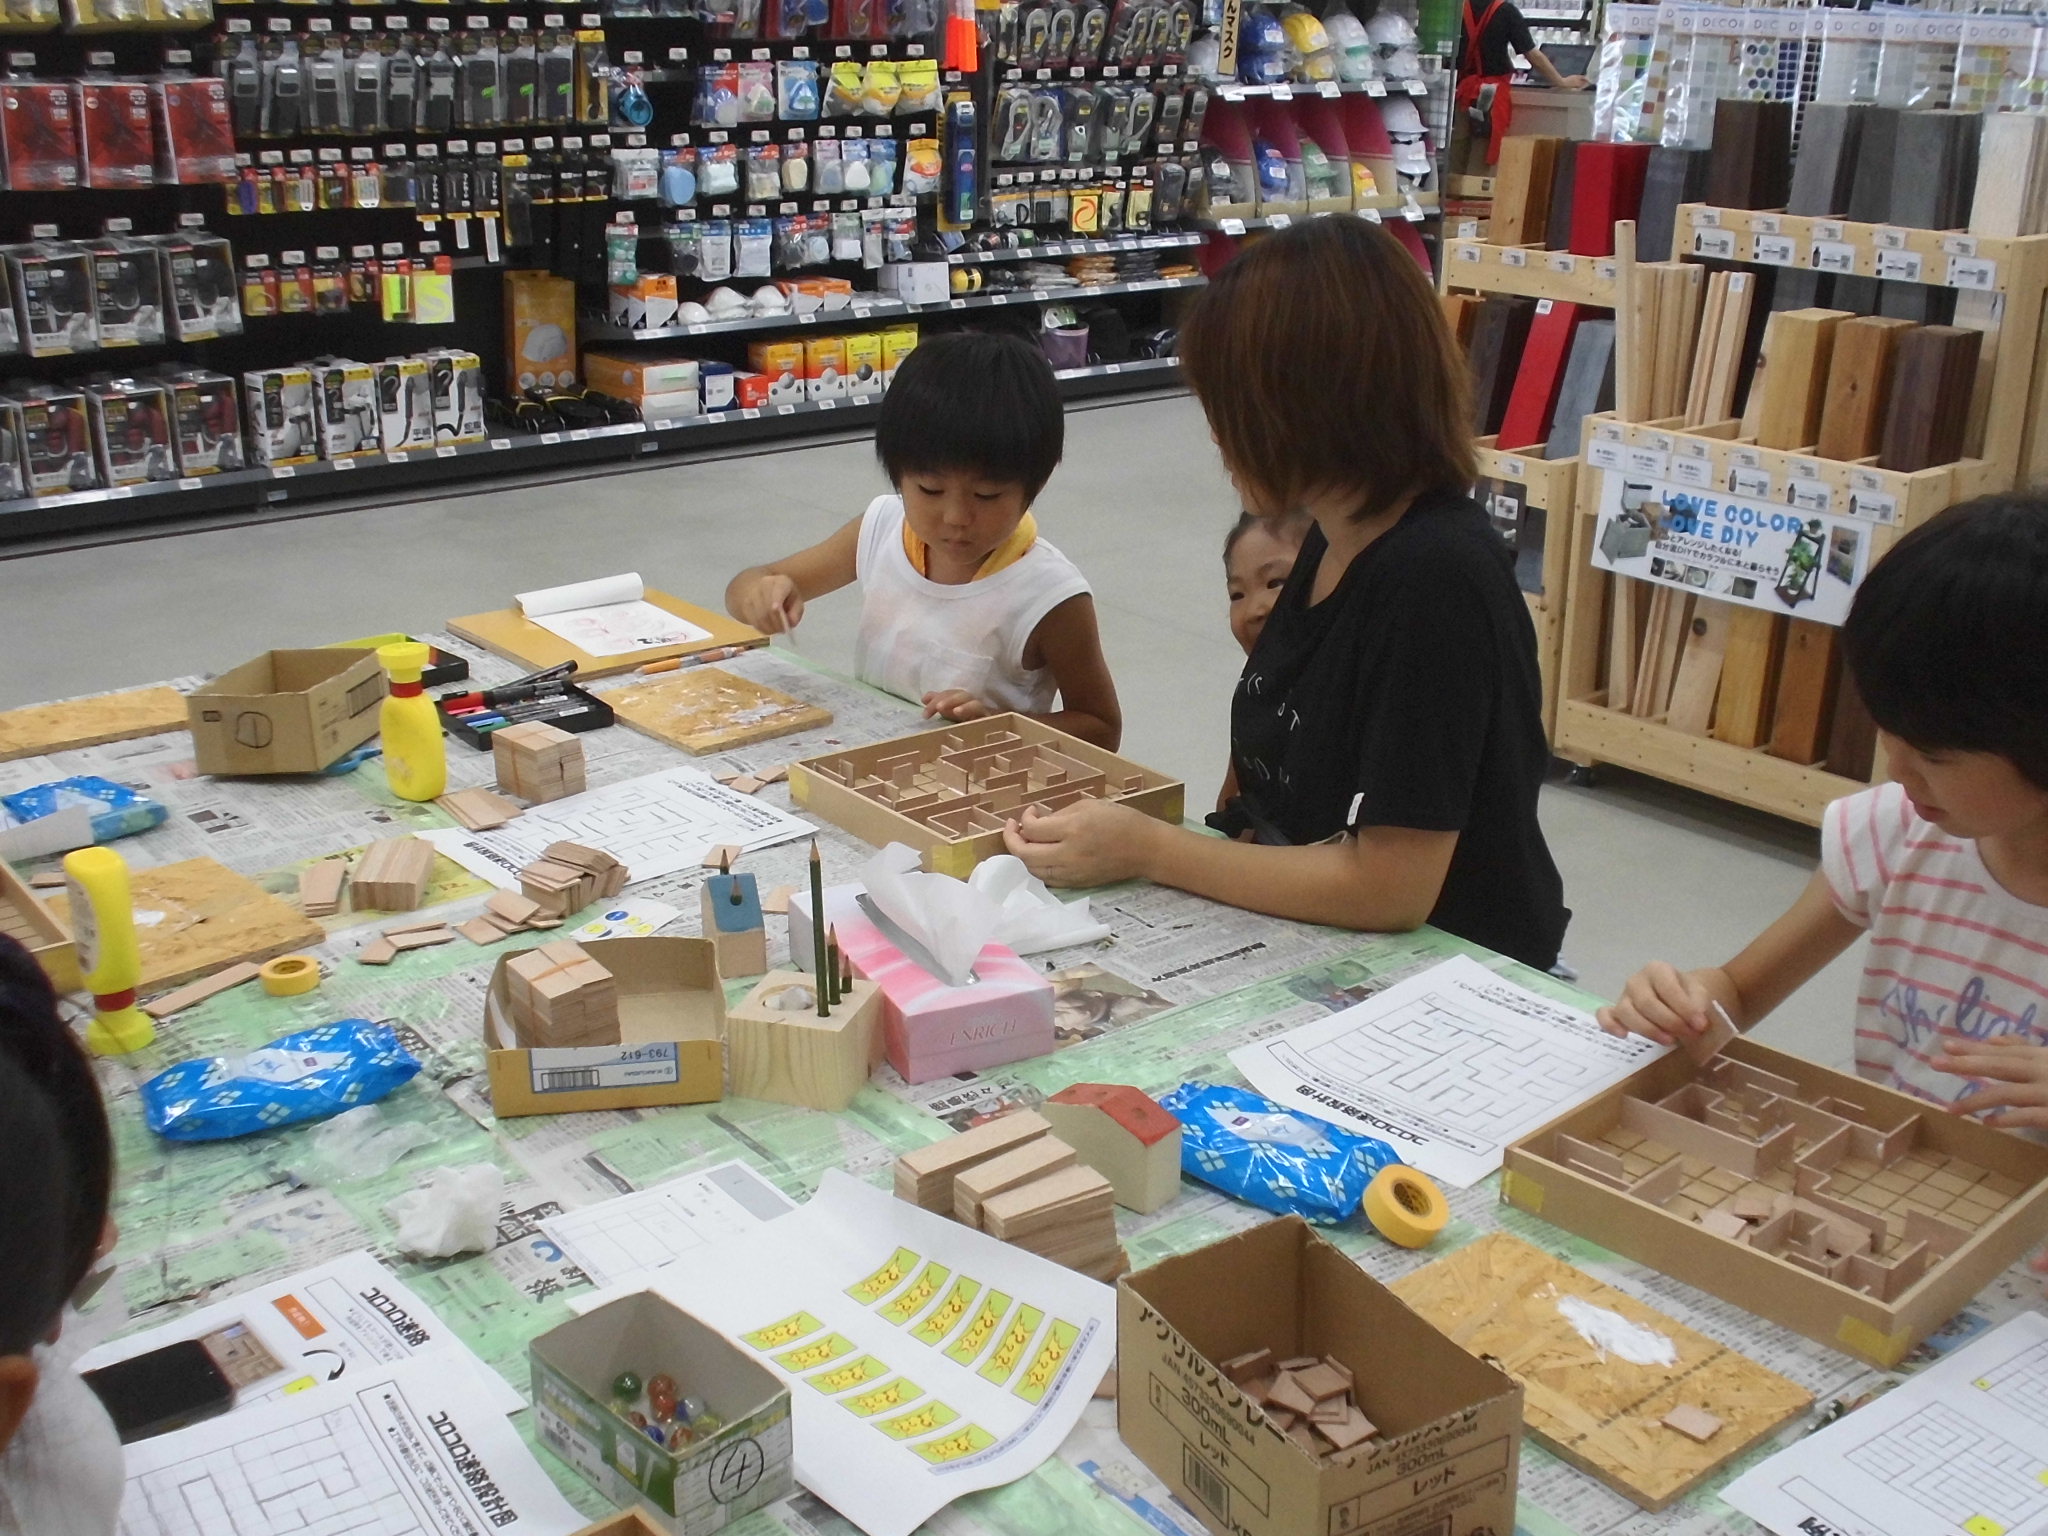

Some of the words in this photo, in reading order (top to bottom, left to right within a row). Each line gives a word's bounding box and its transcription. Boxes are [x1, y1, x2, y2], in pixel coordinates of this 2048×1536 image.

[1662, 490, 1718, 517] LOVE
[1725, 505, 1802, 534] COLOR
[1721, 525, 1759, 547] DIY
[621, 1048, 668, 1062] 793-612
[359, 1287, 430, 1347] コロコロ迷路
[1181, 1387, 1231, 1447] 300mL
[427, 1411, 519, 1528] コロコロ迷路設計図
[1396, 1448, 1449, 1476] 300mL
[1411, 1466, 1457, 1497] レッド
